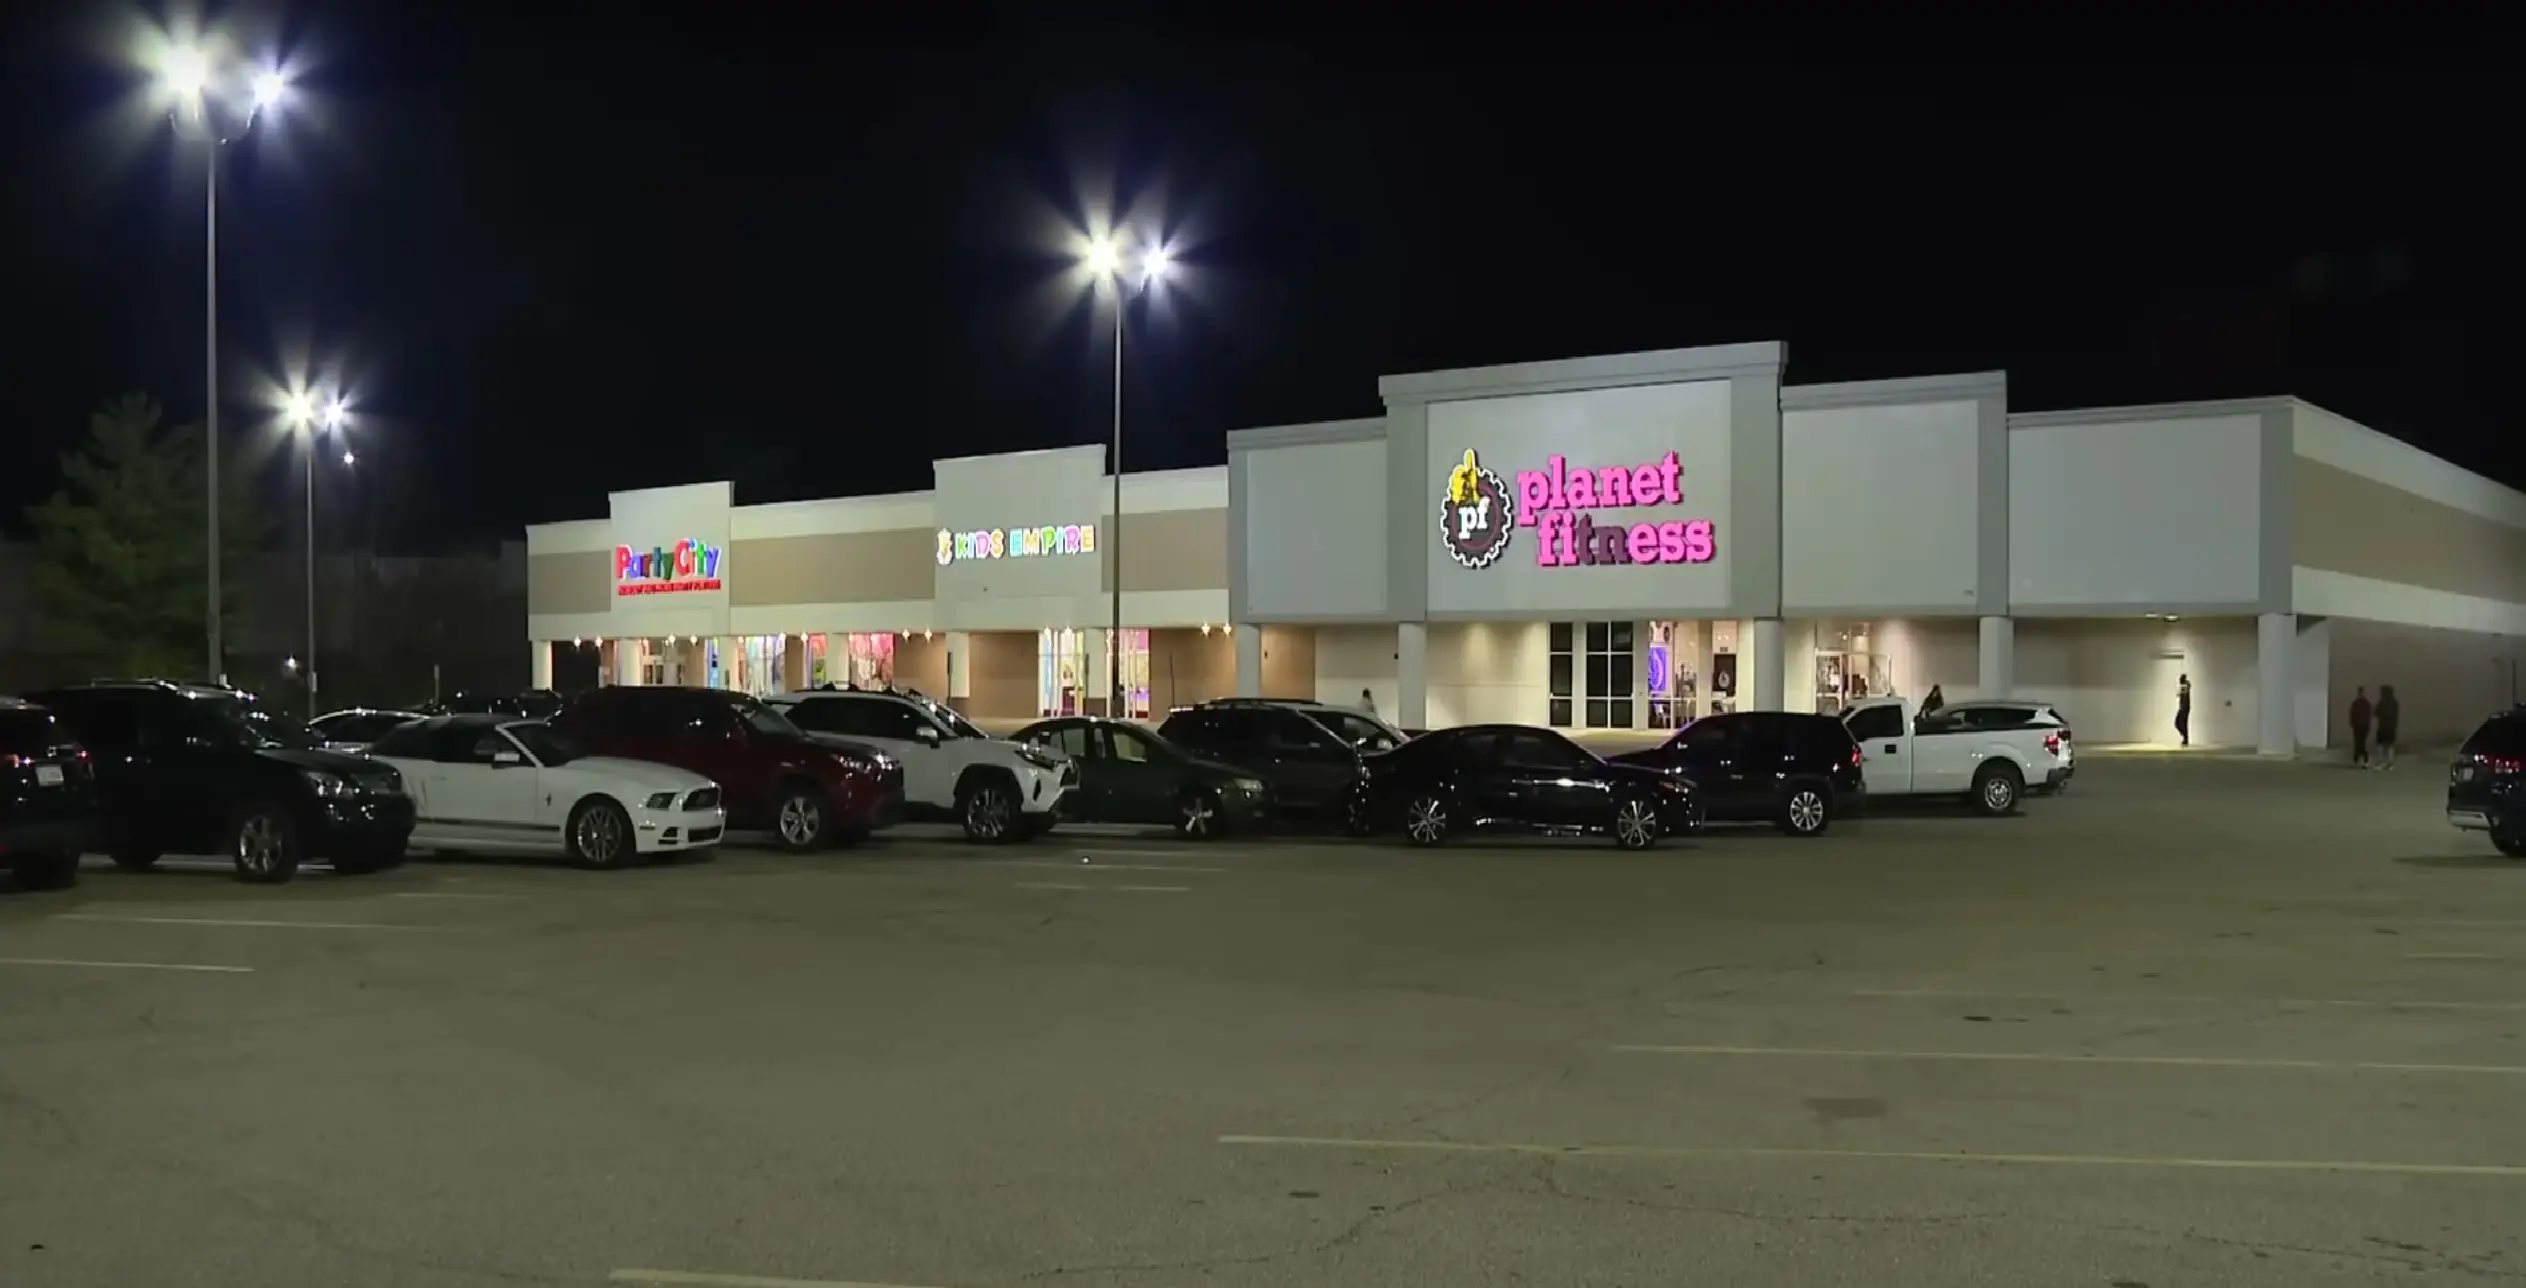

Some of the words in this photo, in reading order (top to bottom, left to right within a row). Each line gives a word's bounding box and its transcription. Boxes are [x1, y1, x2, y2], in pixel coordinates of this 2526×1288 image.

[1517, 451, 1683, 525] planet
[955, 529, 1004, 559] KIDS
[1009, 525, 1095, 556] EMPIRE
[1458, 499, 1490, 539] pf
[1538, 512, 1715, 565] fitness
